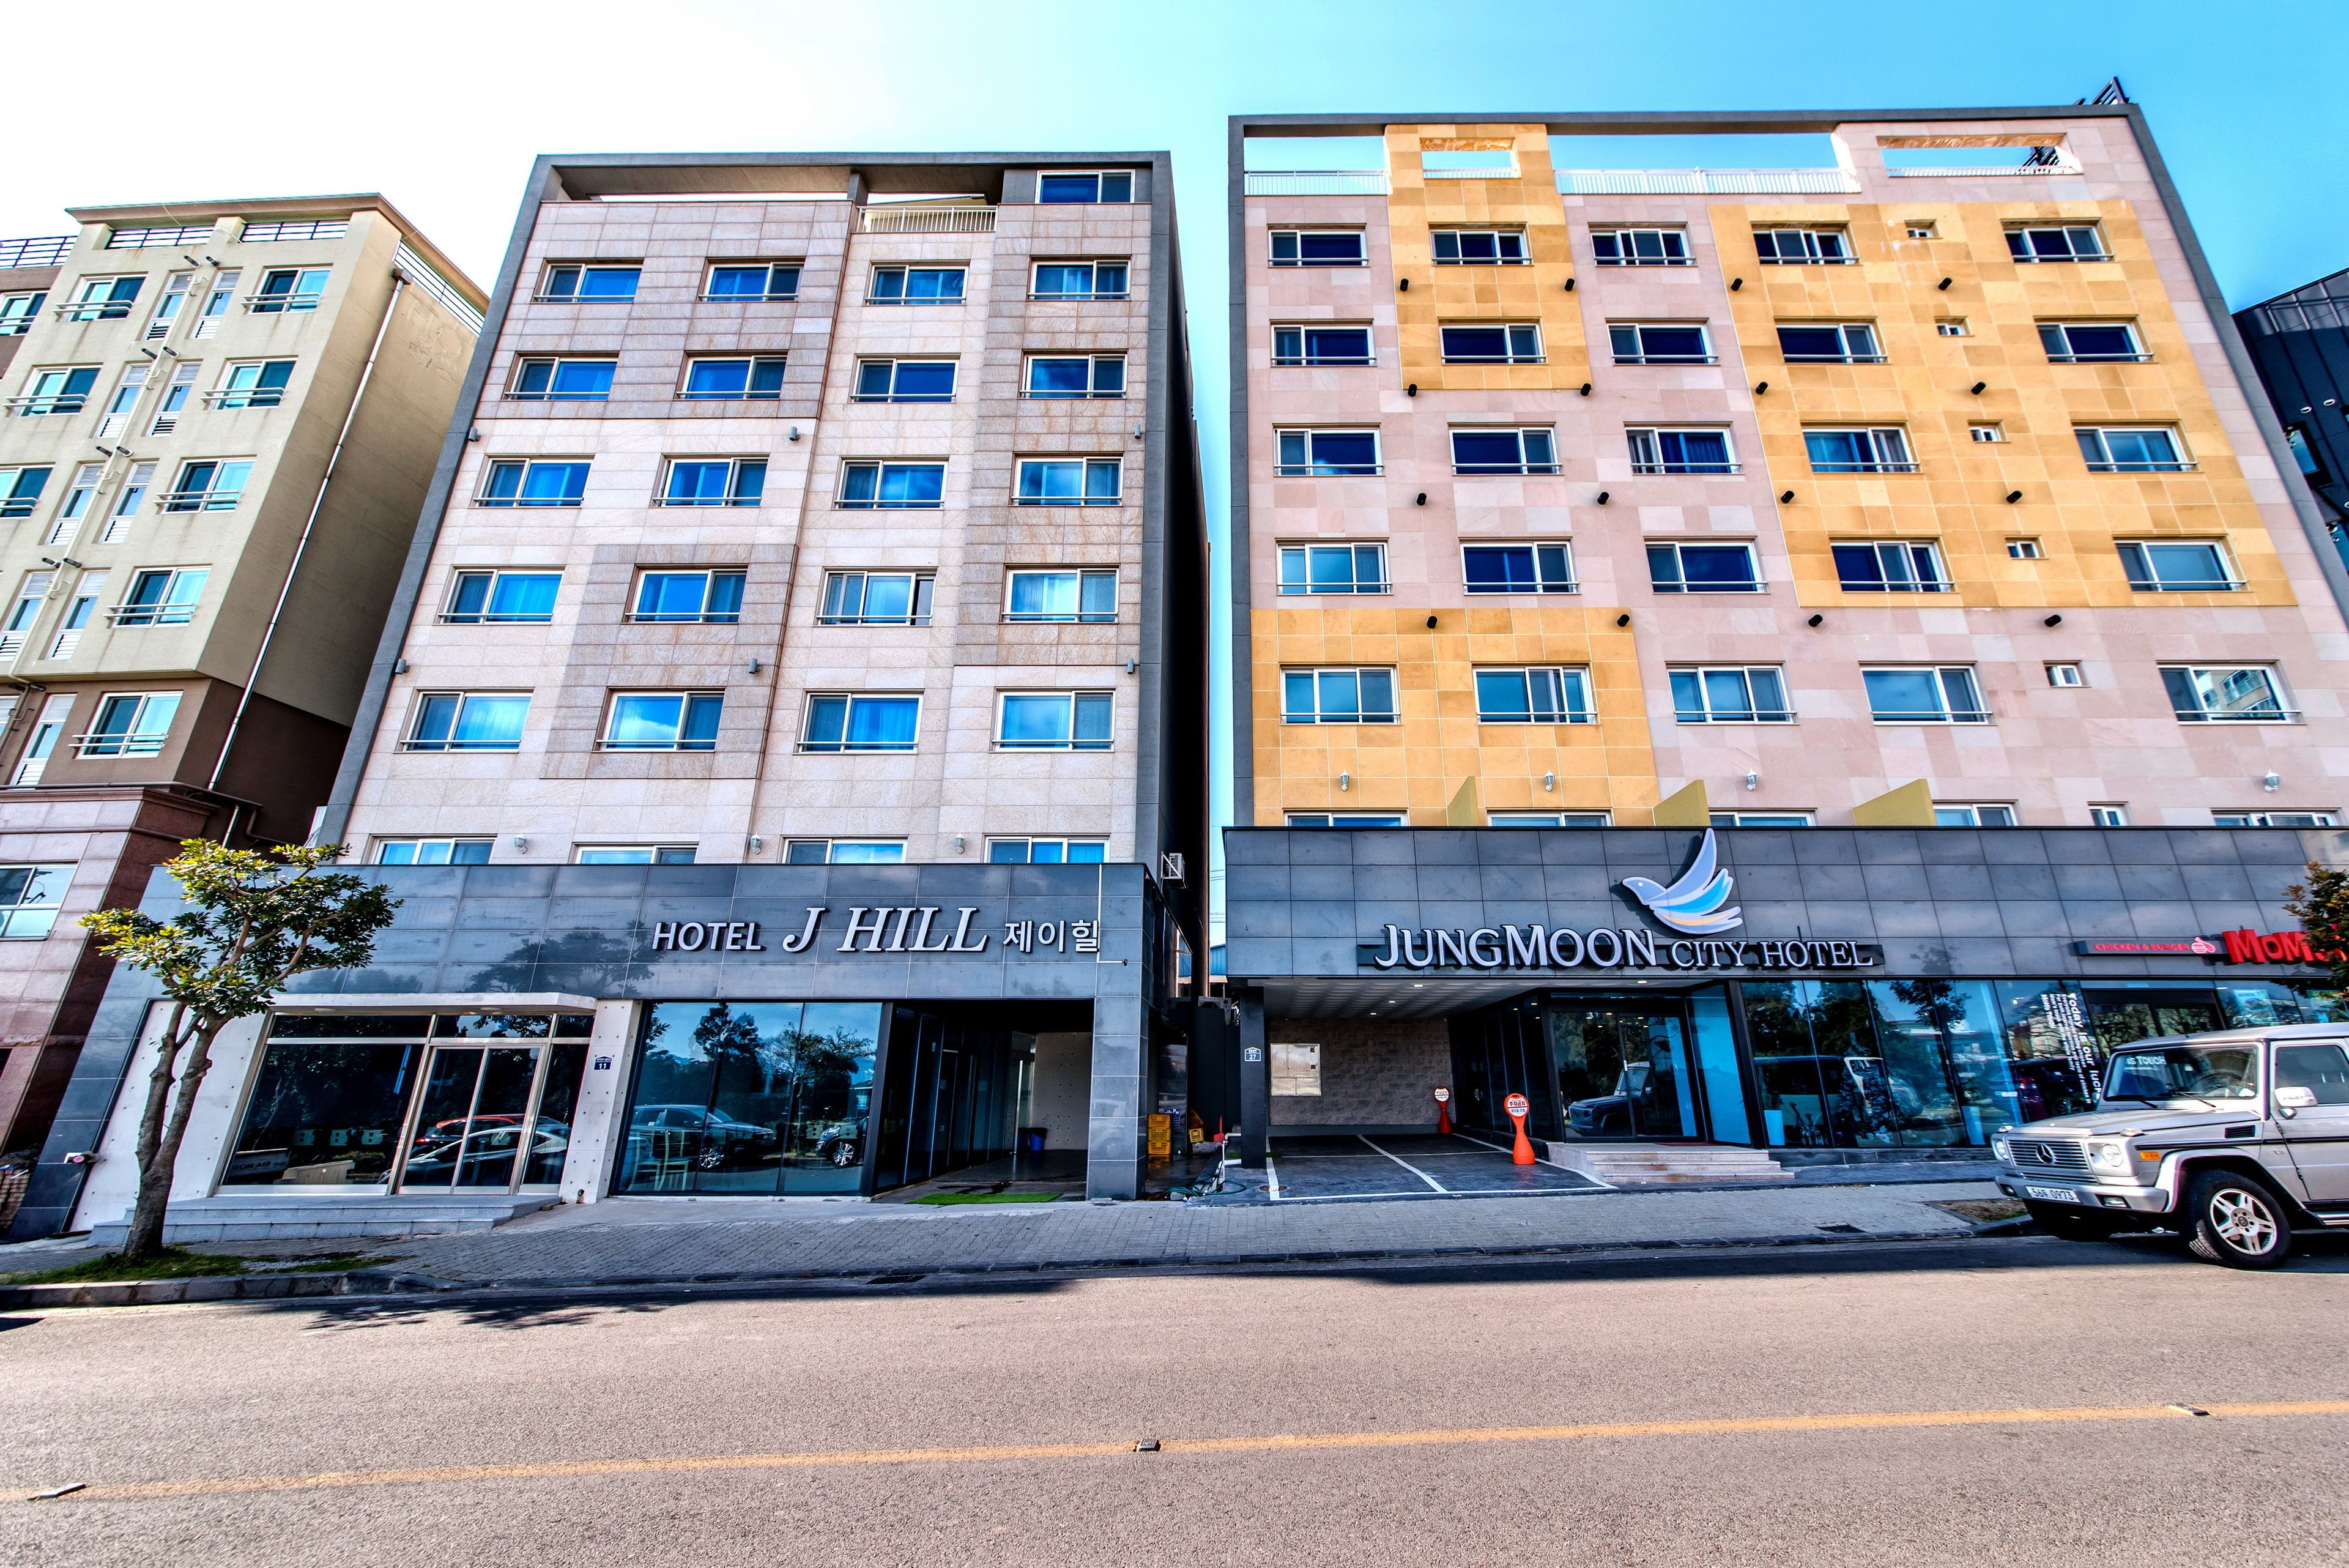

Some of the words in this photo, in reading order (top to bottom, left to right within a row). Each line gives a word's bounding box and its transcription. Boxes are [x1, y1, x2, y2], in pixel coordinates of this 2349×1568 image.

[652, 922, 762, 950] HOTEL
[782, 907, 826, 952] J
[836, 907, 988, 951] HILL
[1003, 920, 1099, 953] 제이힐
[1374, 924, 1656, 967] JUNGMOON
[1671, 941, 1748, 967] CITY
[1760, 940, 1874, 967] HOTEL
[2150, 943, 2189, 951] BURGER
[2068, 992, 2083, 1027] Today
[2083, 1046, 2095, 1066] our
[2077, 1050, 2086, 1067] chicken
[2136, 1056, 2167, 1065] TOUCH
[2080, 1079, 2089, 1097] chicken
[2050, 1190, 2074, 1200] 0973
